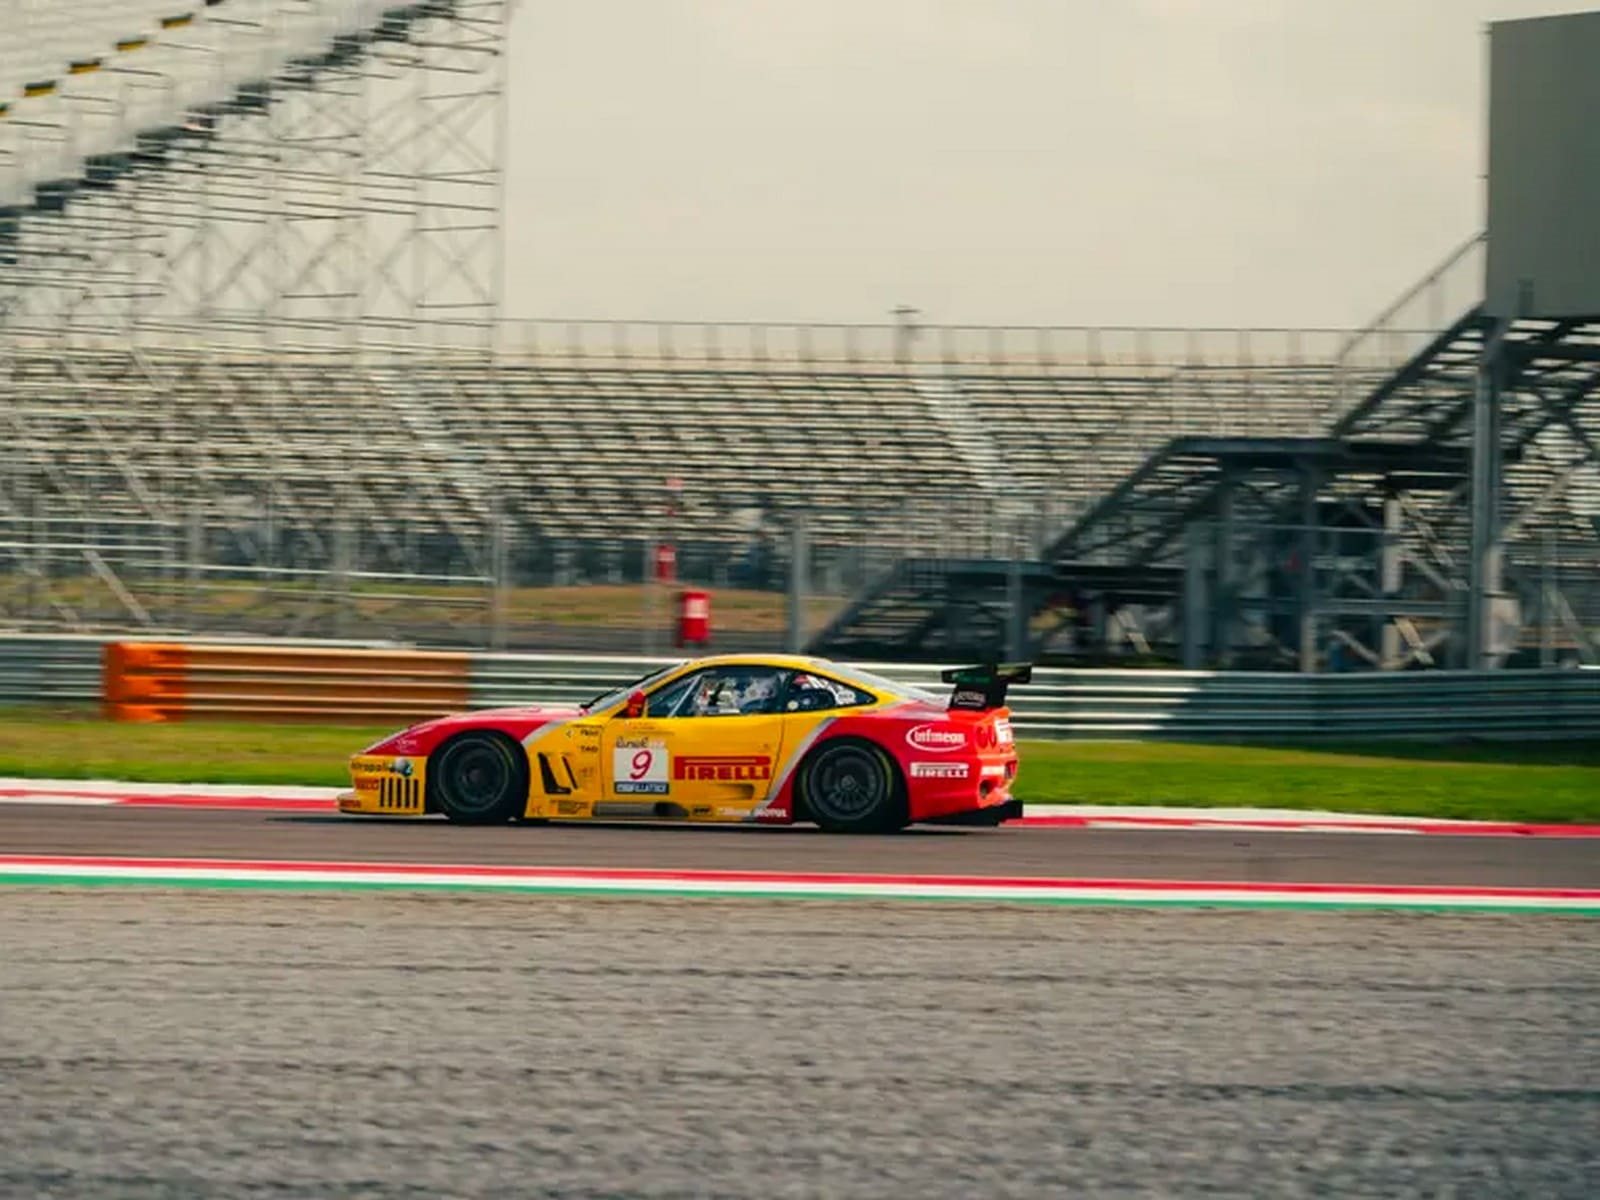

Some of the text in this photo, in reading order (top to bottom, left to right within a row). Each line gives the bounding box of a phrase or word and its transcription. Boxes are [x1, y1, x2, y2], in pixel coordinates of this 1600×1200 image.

[630, 750, 653, 780] 9
[674, 756, 771, 780] PIRELLI
[910, 762, 970, 778] PIRELLI
